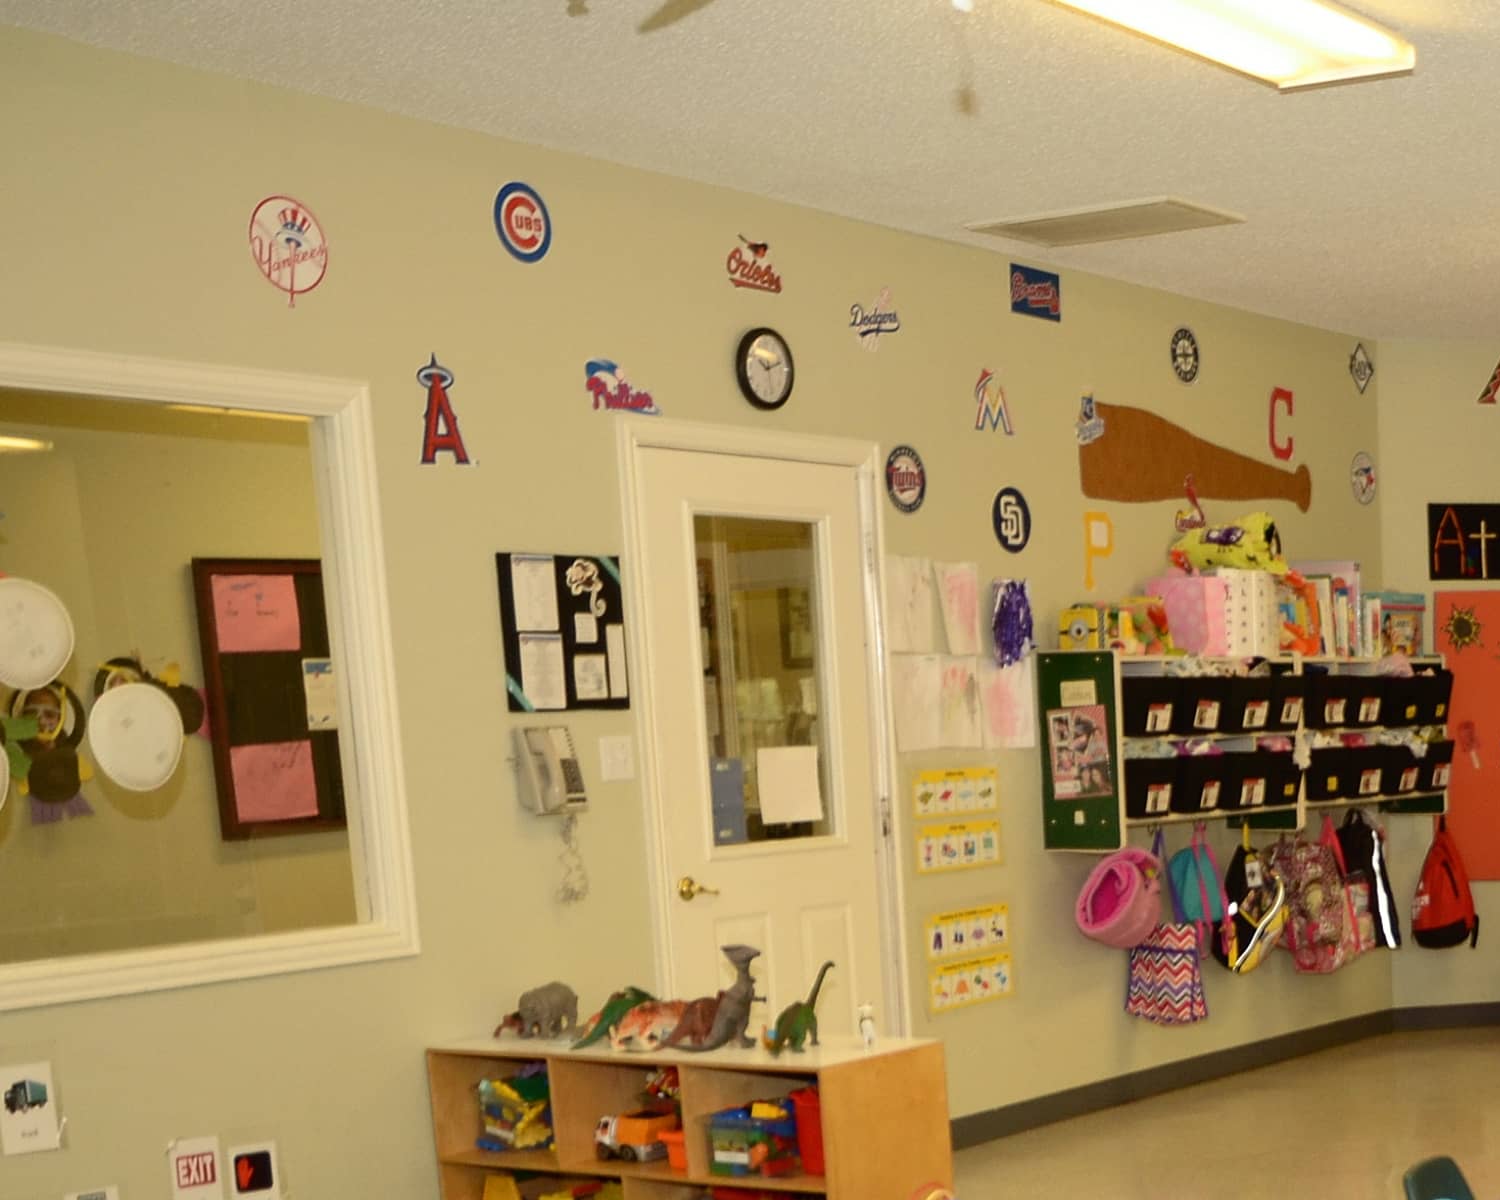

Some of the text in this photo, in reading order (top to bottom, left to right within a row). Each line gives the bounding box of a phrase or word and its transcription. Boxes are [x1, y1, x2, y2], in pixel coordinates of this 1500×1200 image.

[727, 247, 782, 293] Orioles
[850, 303, 900, 337] Dodgers
[1268, 386, 1294, 462] C
[1083, 511, 1113, 592] P
[178, 1156, 214, 1186] EXIT
